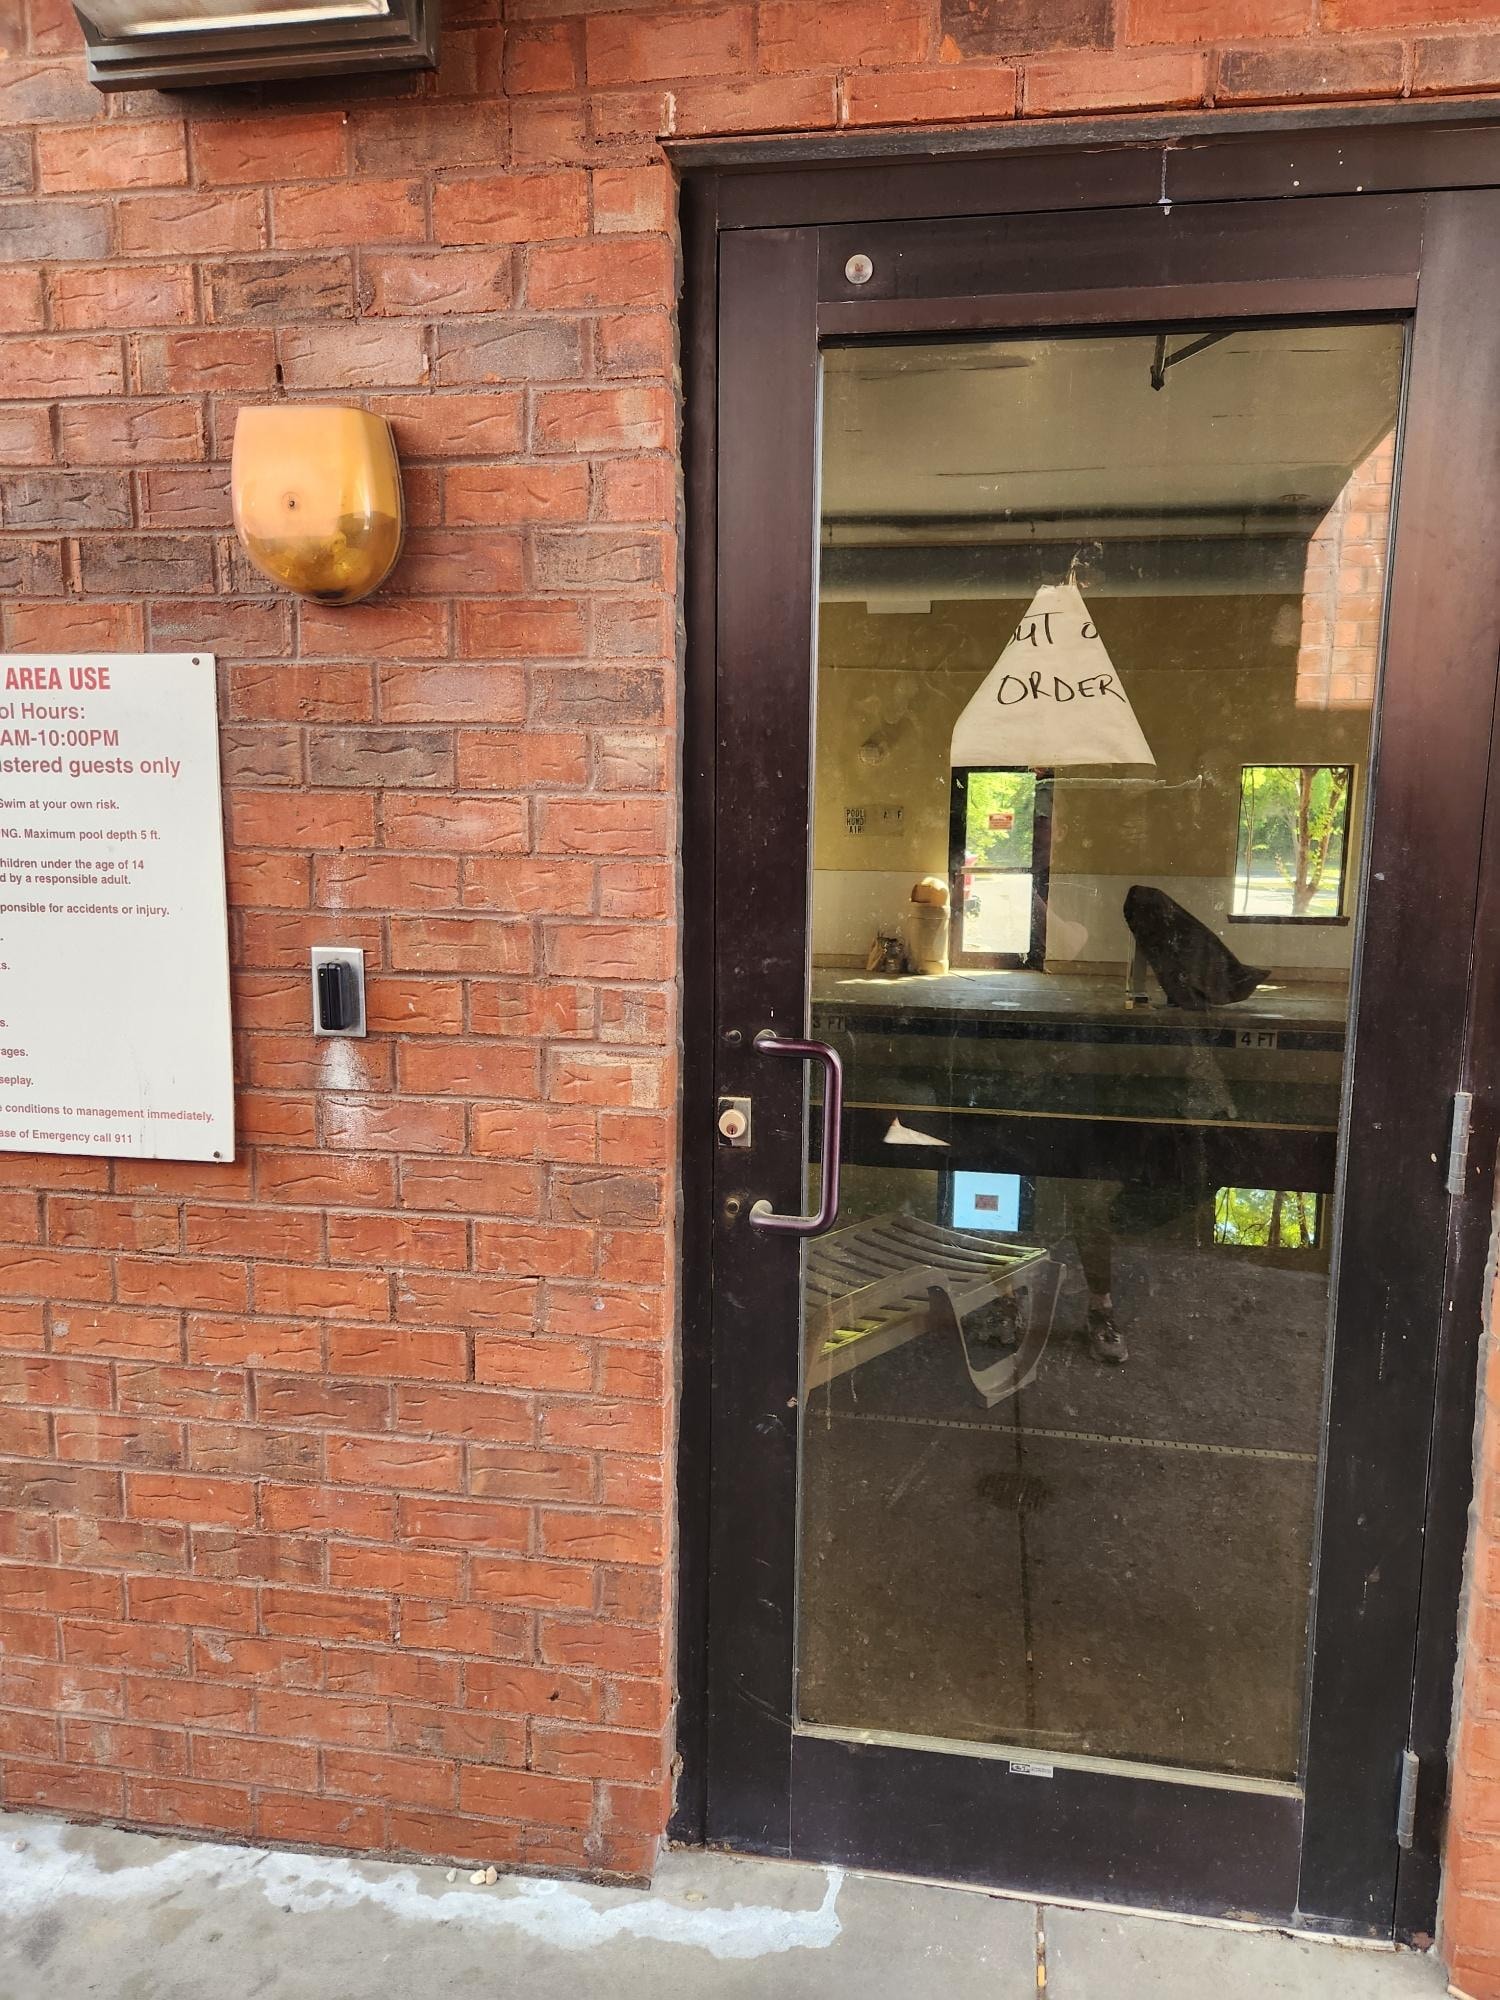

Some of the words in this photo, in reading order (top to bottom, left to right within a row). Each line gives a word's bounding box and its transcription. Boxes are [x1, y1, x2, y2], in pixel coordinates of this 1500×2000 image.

[1008, 611, 1064, 647] UT
[5, 667, 63, 690] AREA
[69, 667, 111, 690] USE
[997, 671, 1126, 705] ORDER
[21, 703, 85, 719] Hours:
[0, 729, 119, 746] AM-10:00PM
[69, 759, 133, 778] guests
[140, 757, 180, 778] only
[30, 800, 40, 808] at
[43, 801, 67, 811] your
[96, 800, 119, 809] risk.
[24, 829, 75, 839] Maximum
[79, 830, 103, 841] pool
[106, 830, 137, 842] depth
[141, 830, 147, 839] 5
[150, 830, 160, 839] ft.
[41, 859, 72, 868] under
[75, 860, 92, 869] the
[95, 861, 114, 872] age
[118, 860, 128, 869] of
[132, 860, 144, 869] 14
[9, 873, 22, 885] by
[25, 875, 32, 883] a
[35, 874, 97, 885] responsible
[101, 875, 131, 884] adult.
[49, 903, 64, 912] for
[67, 904, 118, 914] accidents
[136, 905, 169, 917] injury.
[1241, 1031, 1251, 1046] 4
[1257, 1032, 1275, 1047] FT
[0, 1048, 28, 1058] ages.
[5, 1104, 60, 1114] conditions
[63, 1106, 73, 1115] to
[77, 1108, 144, 1119] management
[148, 1109, 214, 1122] immediately.
[19, 1129, 29, 1138] of
[33, 1130, 90, 1143] Emergency
[93, 1133, 111, 1142] call
[115, 1134, 131, 1143] 911
